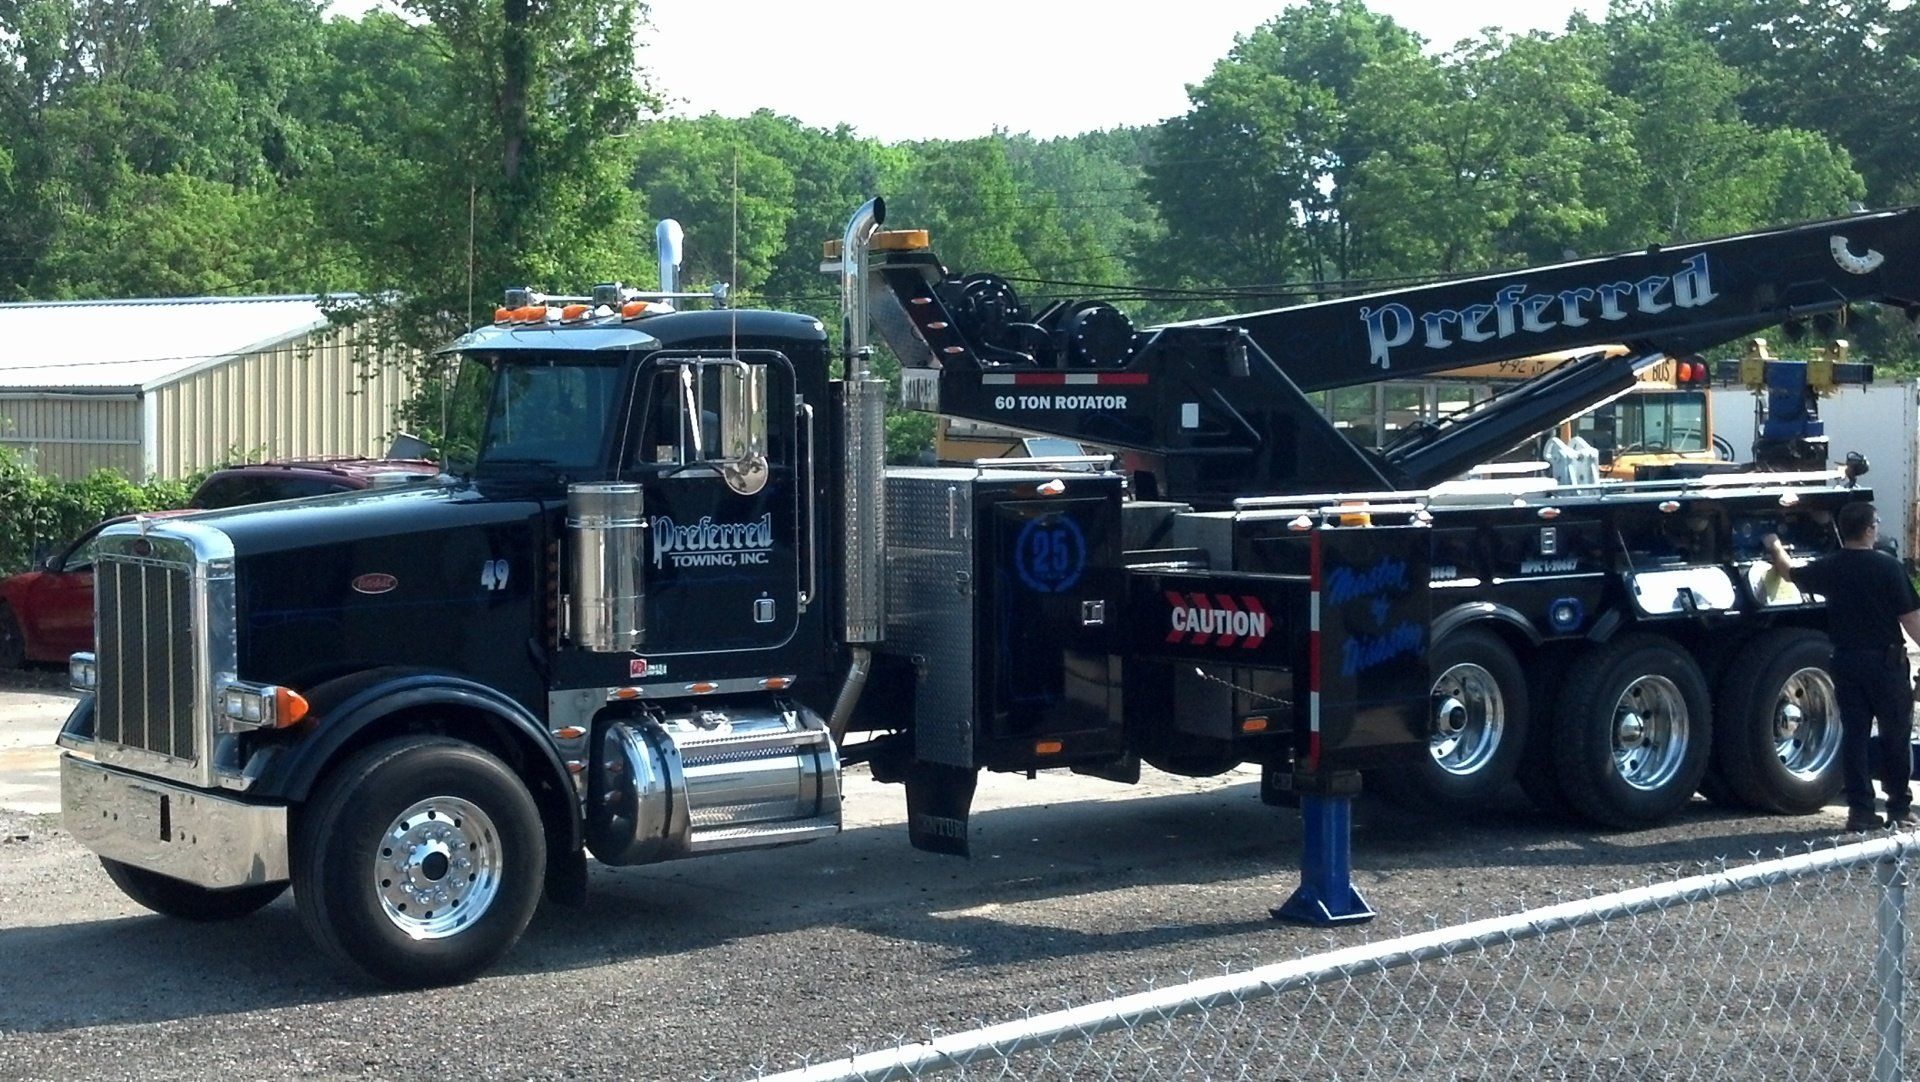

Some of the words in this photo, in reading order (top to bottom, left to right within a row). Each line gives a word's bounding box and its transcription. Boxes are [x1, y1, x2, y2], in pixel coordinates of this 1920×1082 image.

[1360, 252, 1719, 369] Preferred
[1652, 359, 1671, 382] BUS
[994, 396, 1016, 410] 60
[1019, 396, 1051, 410] TON
[1055, 396, 1127, 410] ROTATOR
[650, 512, 774, 570] Preferred
[1032, 530, 1069, 572] 25
[481, 559, 510, 590] 49
[671, 553, 737, 568] TOWING,
[740, 552, 769, 565] INC.
[1171, 606, 1265, 638] CAUTION
